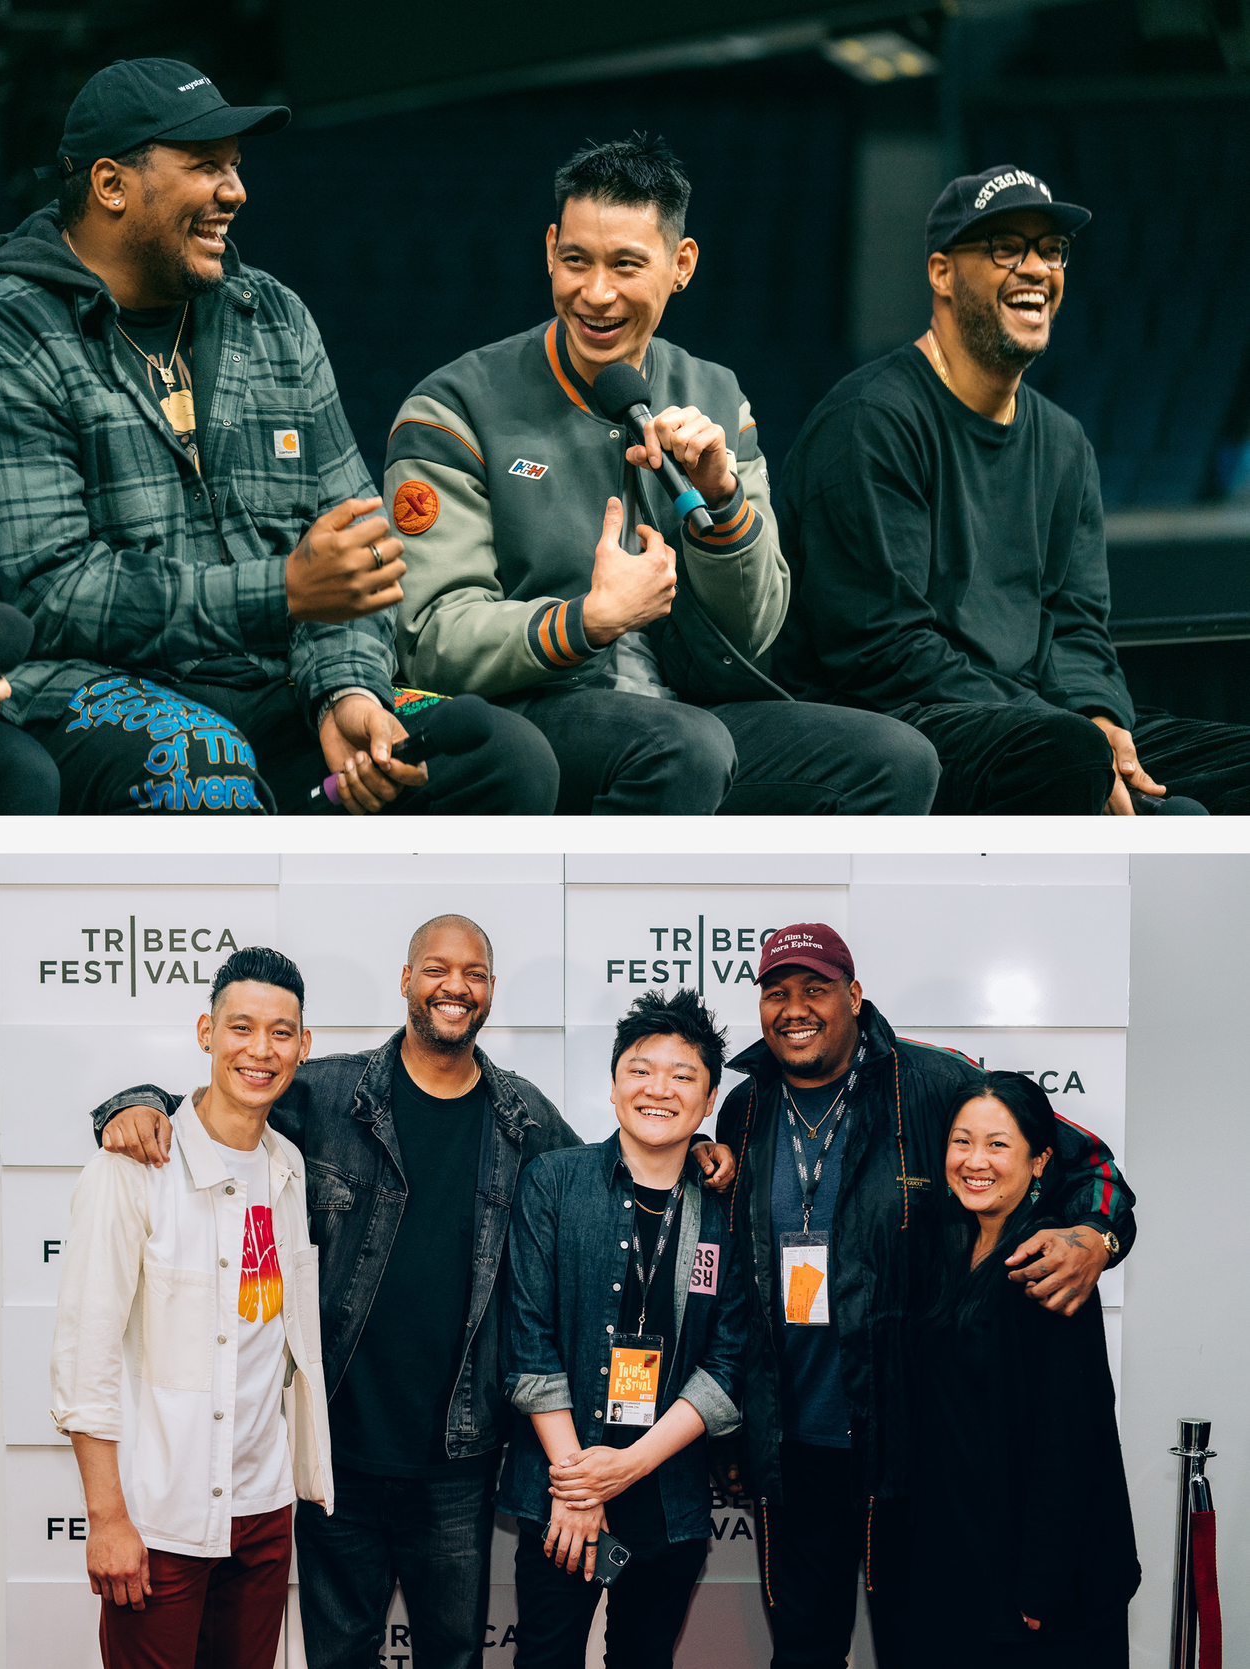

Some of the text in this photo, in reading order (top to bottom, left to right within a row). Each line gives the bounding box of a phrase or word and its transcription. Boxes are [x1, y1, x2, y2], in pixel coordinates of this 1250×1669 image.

[784, 934, 801, 942] film
[803, 933, 813, 941] by
[770, 940, 823, 956] Nora Ephron
